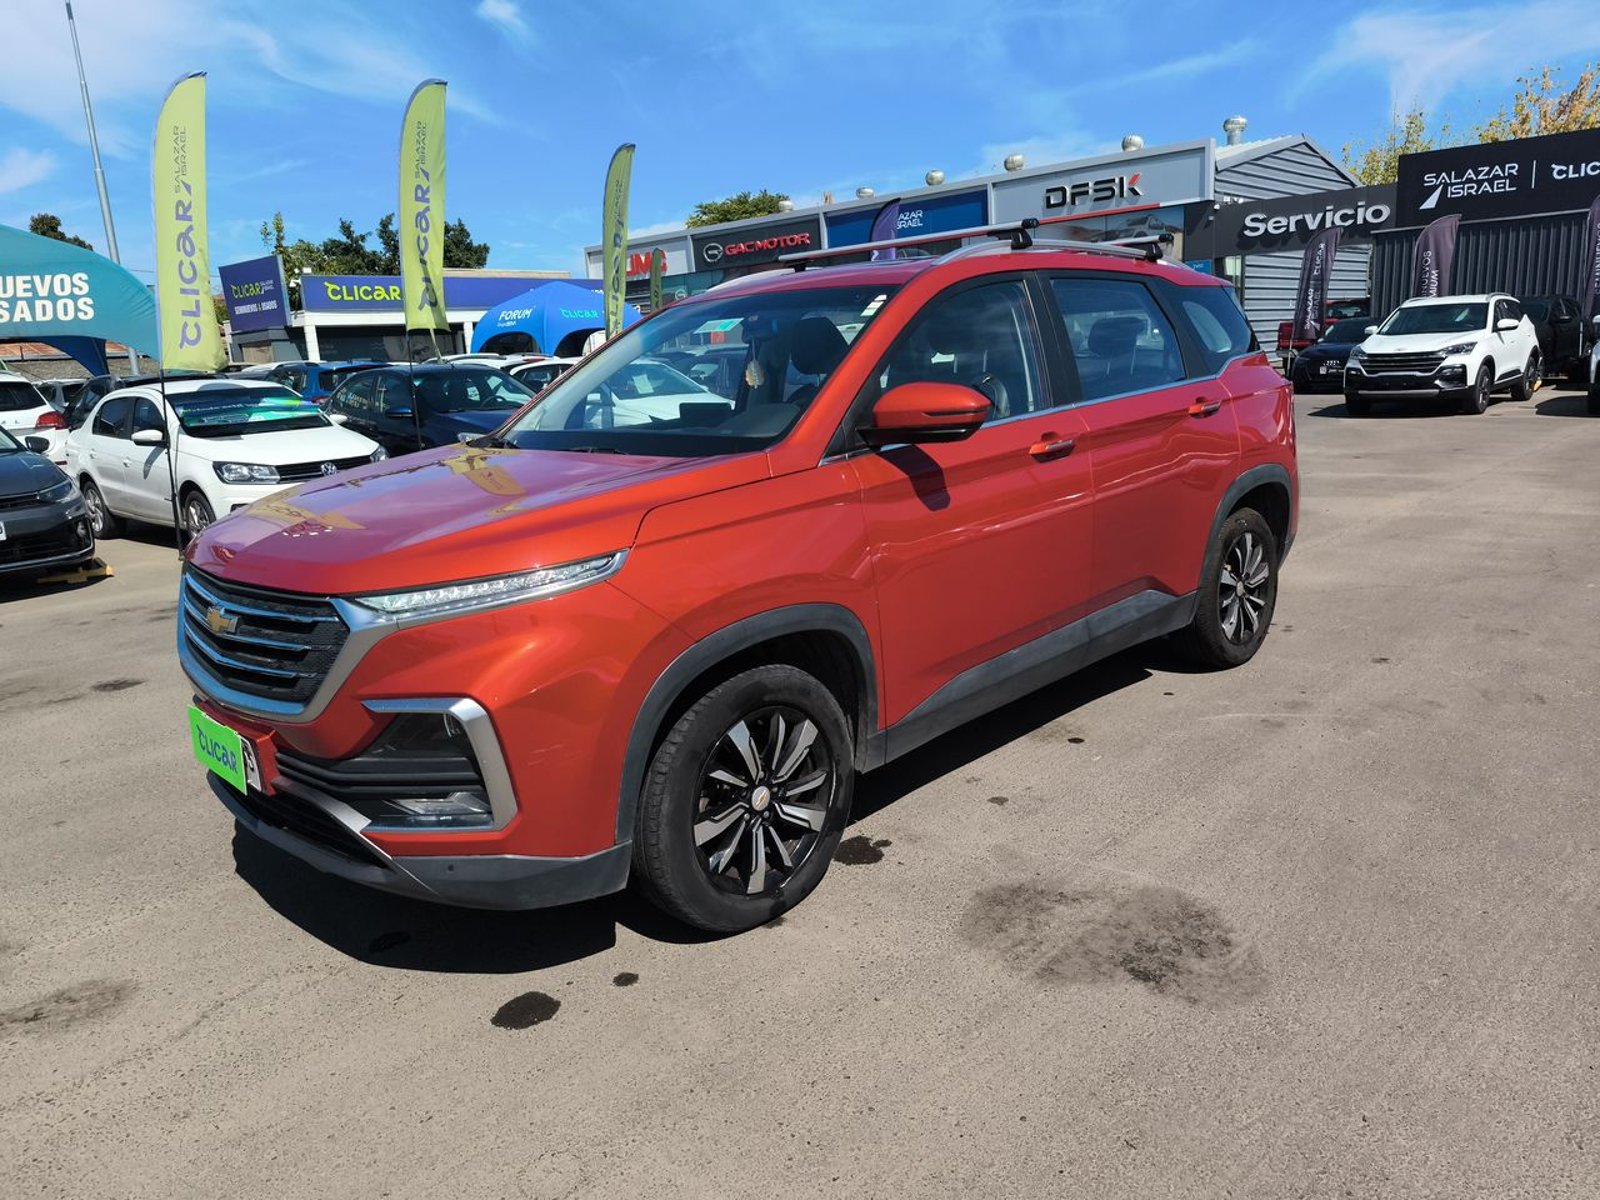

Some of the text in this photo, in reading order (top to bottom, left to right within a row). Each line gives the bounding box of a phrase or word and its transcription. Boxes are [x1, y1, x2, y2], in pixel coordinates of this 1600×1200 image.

[1423, 162, 1519, 187] SALAZAR
[1045, 172, 1143, 209] DFSK
[1447, 178, 1517, 198] ISRAEL
[897, 209, 924, 221] AZAR
[1243, 201, 1391, 237] Servicio
[498, 308, 533, 321] FORUM
